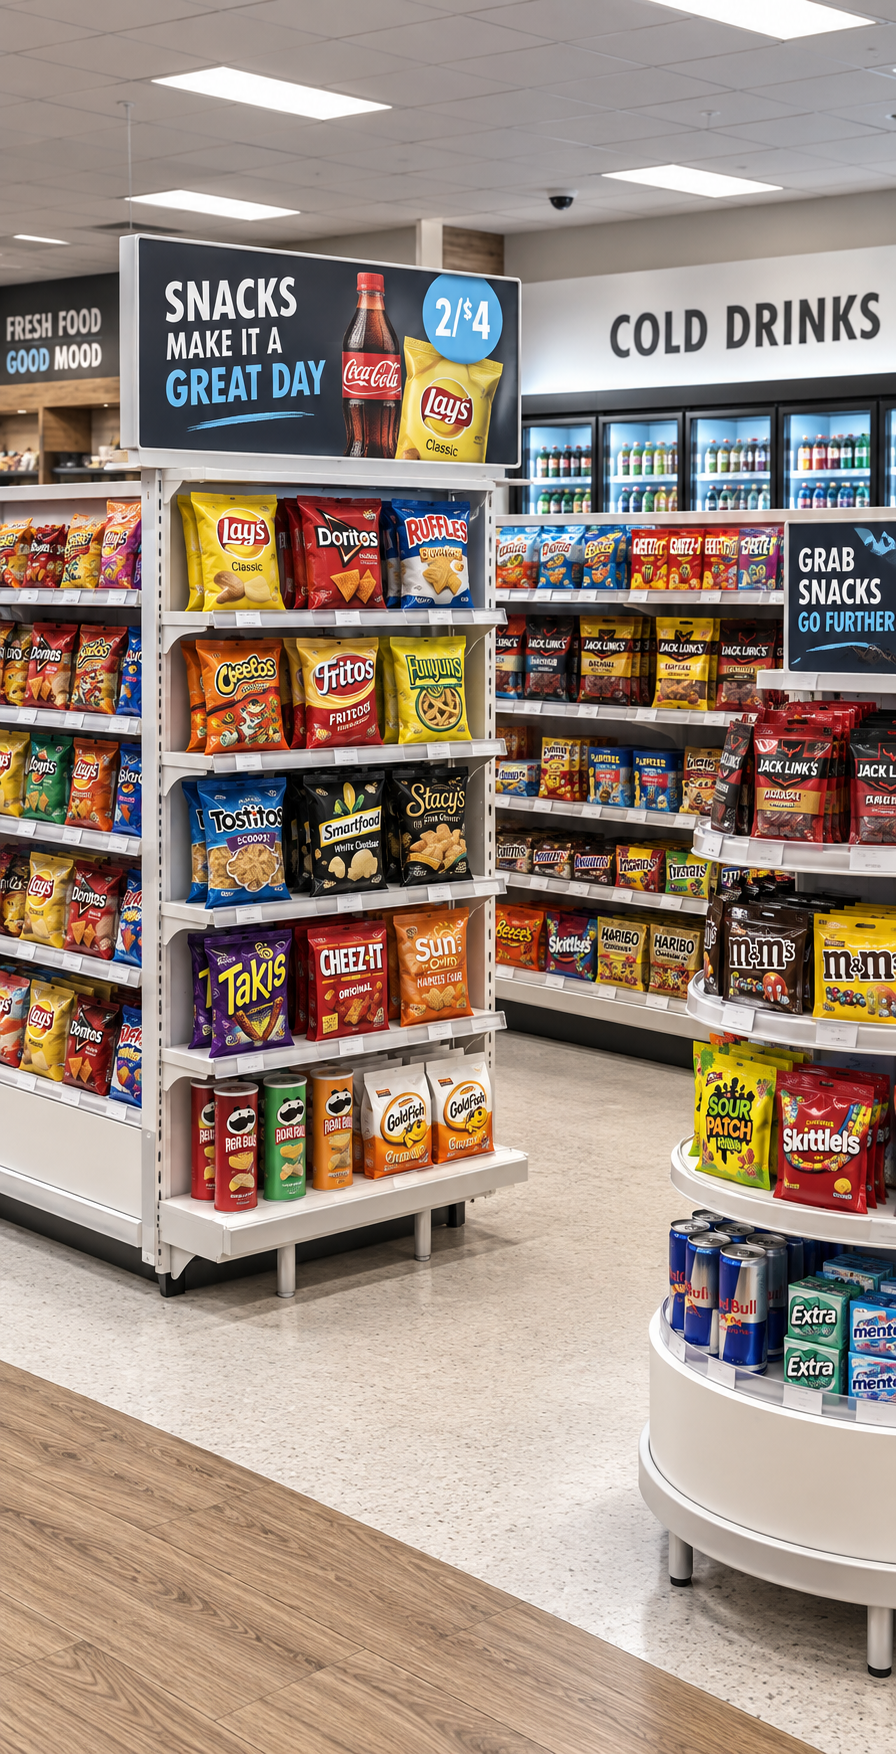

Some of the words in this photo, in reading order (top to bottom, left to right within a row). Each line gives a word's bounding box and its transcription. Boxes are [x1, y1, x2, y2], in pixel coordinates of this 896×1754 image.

[165, 276, 298, 323] SNACKS
[6, 311, 53, 342] FRESH
[57, 306, 102, 338] FOOD
[435, 297, 491, 340] 2/$4
[610, 309, 708, 358] COLD
[726, 292, 881, 350] DRINKS
[166, 328, 233, 361] MAKE
[241, 328, 260, 356] IT
[266, 326, 283, 354] A
[6, 347, 51, 375] GOOD
[54, 342, 102, 371] MOOD
[165, 364, 263, 408] GREAT
[272, 360, 327, 398] DAY
[424, 388, 470, 424] Lay's
[425, 438, 459, 457] Classic
[221, 518, 266, 546] Lay's
[318, 526, 378, 548] Doritos
[406, 514, 468, 549] RUFFLES
[231, 561, 263, 572] Classic
[798, 546, 855, 573] GRAB
[798, 578, 882, 605] SNACKS
[797, 612, 820, 632] GO
[826, 611, 896, 632] FURTHER
[315, 659, 374, 696] Fritos
[757, 759, 784, 773] JACK
[785, 760, 819, 776] LINK'S
[858, 764, 886, 778] JACK
[406, 784, 465, 817] Stacy's
[208, 805, 283, 833] Tostitos
[324, 811, 380, 840] Smartfood
[654, 934, 695, 954] HARIBO
[218, 953, 286, 1015] Takis
[708, 1095, 752, 1121] SOUR
[706, 1116, 752, 1140] PATCH
[731, 1299, 757, 1315] Bull
[791, 1305, 837, 1325] Extra
[787, 1357, 834, 1377] Extra
